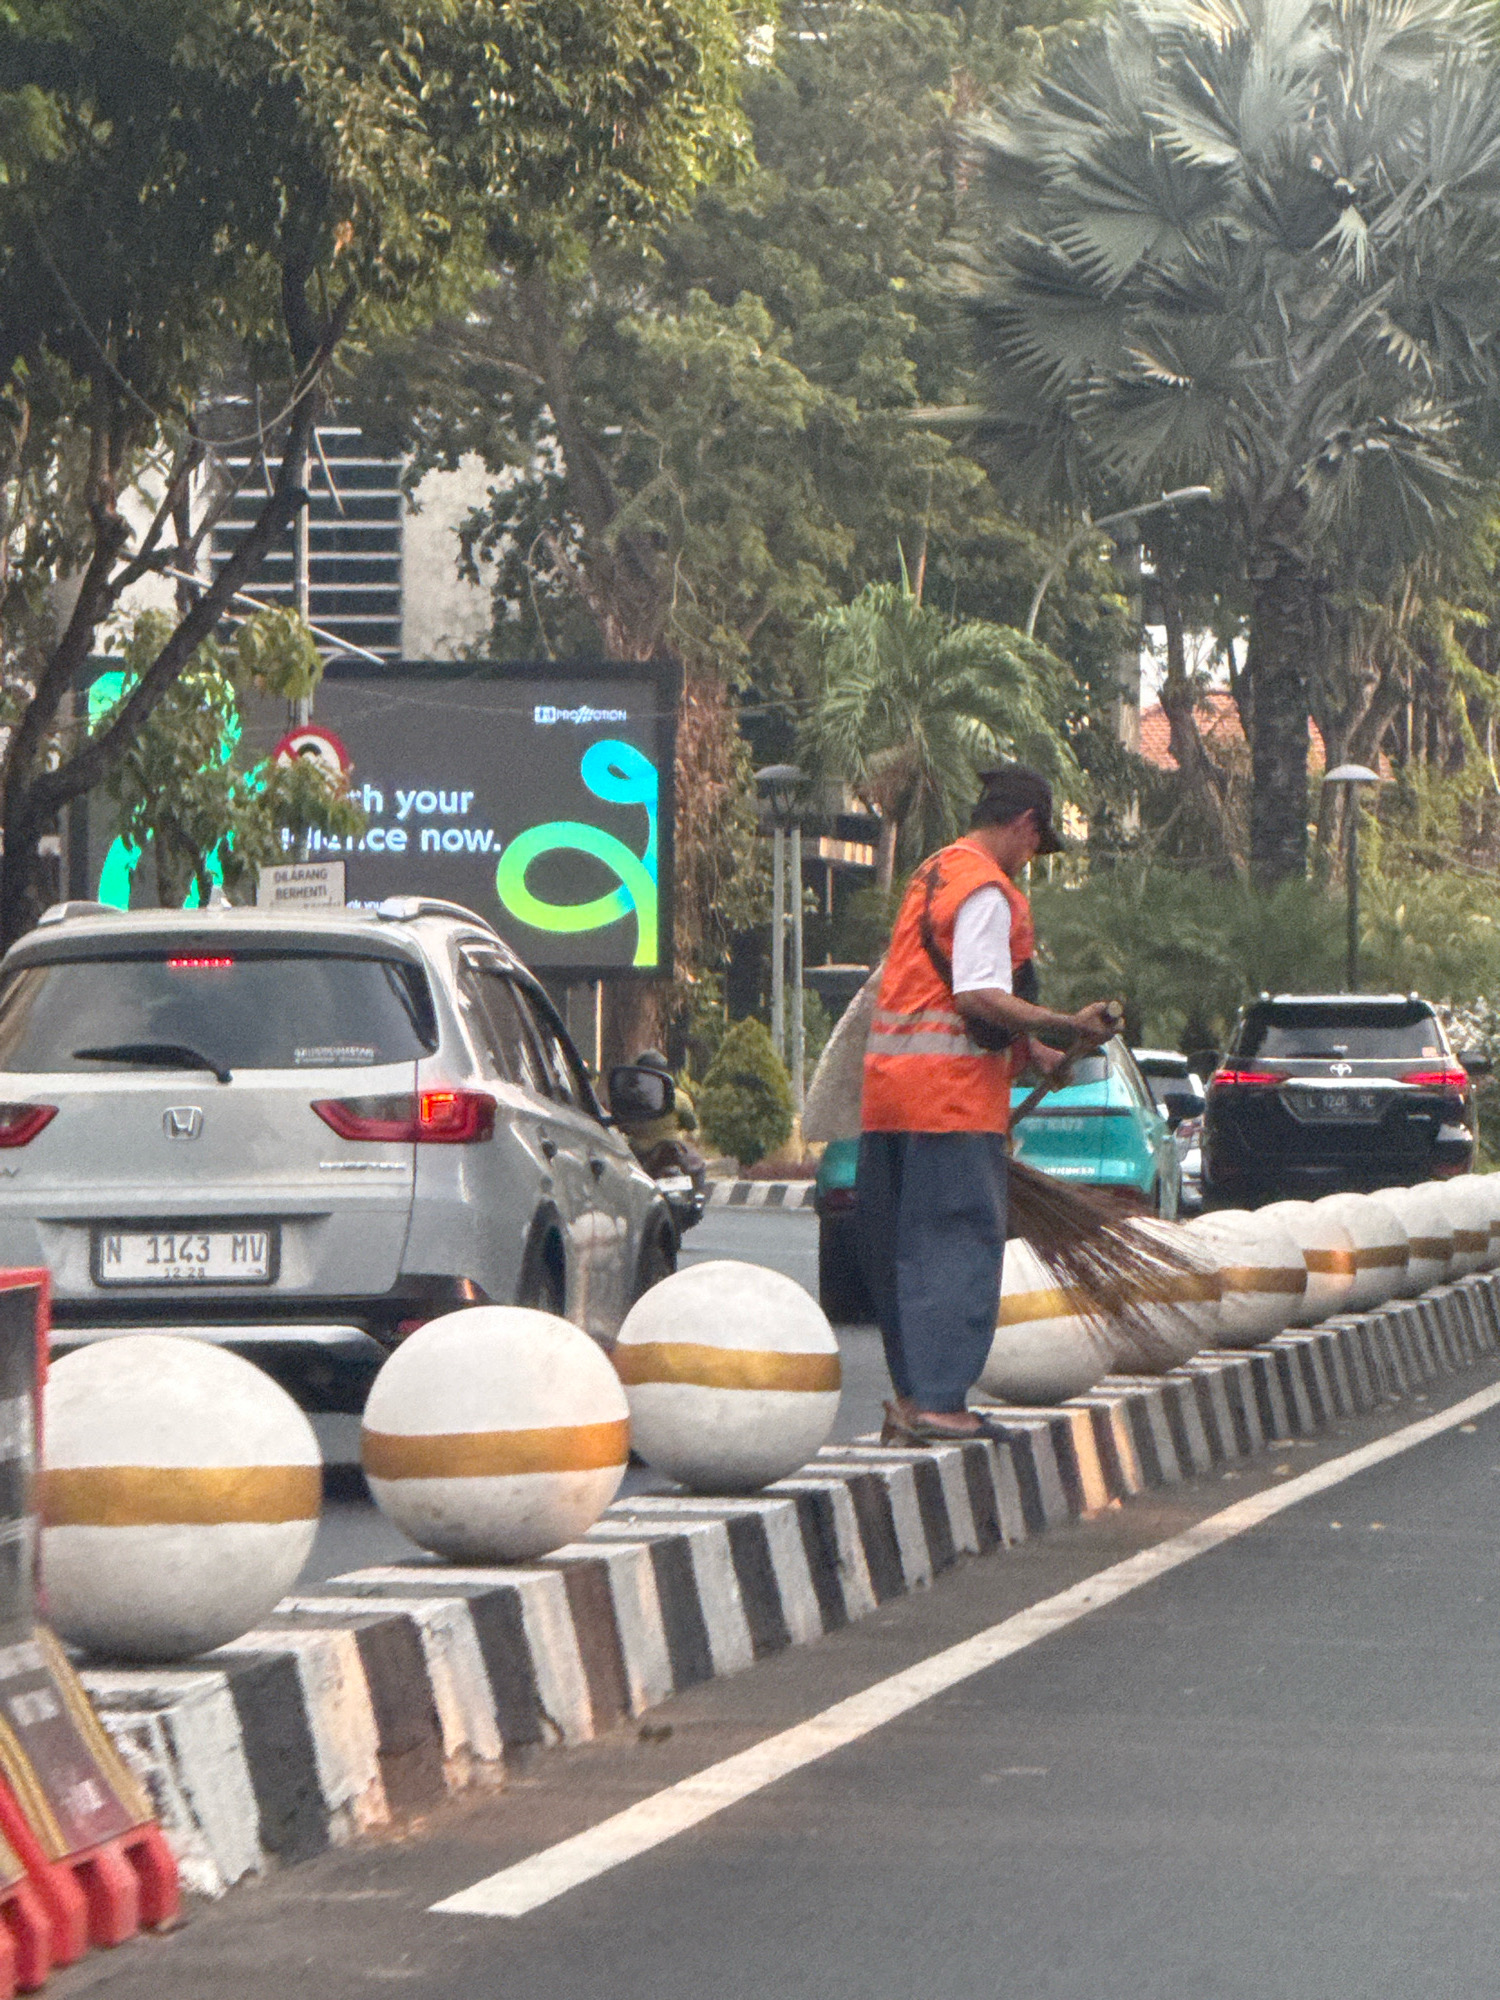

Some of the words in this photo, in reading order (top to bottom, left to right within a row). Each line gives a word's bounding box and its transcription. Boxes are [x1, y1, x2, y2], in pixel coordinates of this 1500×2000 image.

[395, 789, 475, 820] your
[420, 828, 501, 852] now.
[106, 1235, 122, 1264] N
[147, 1234, 211, 1264] 1143
[231, 1234, 265, 1262] MV
